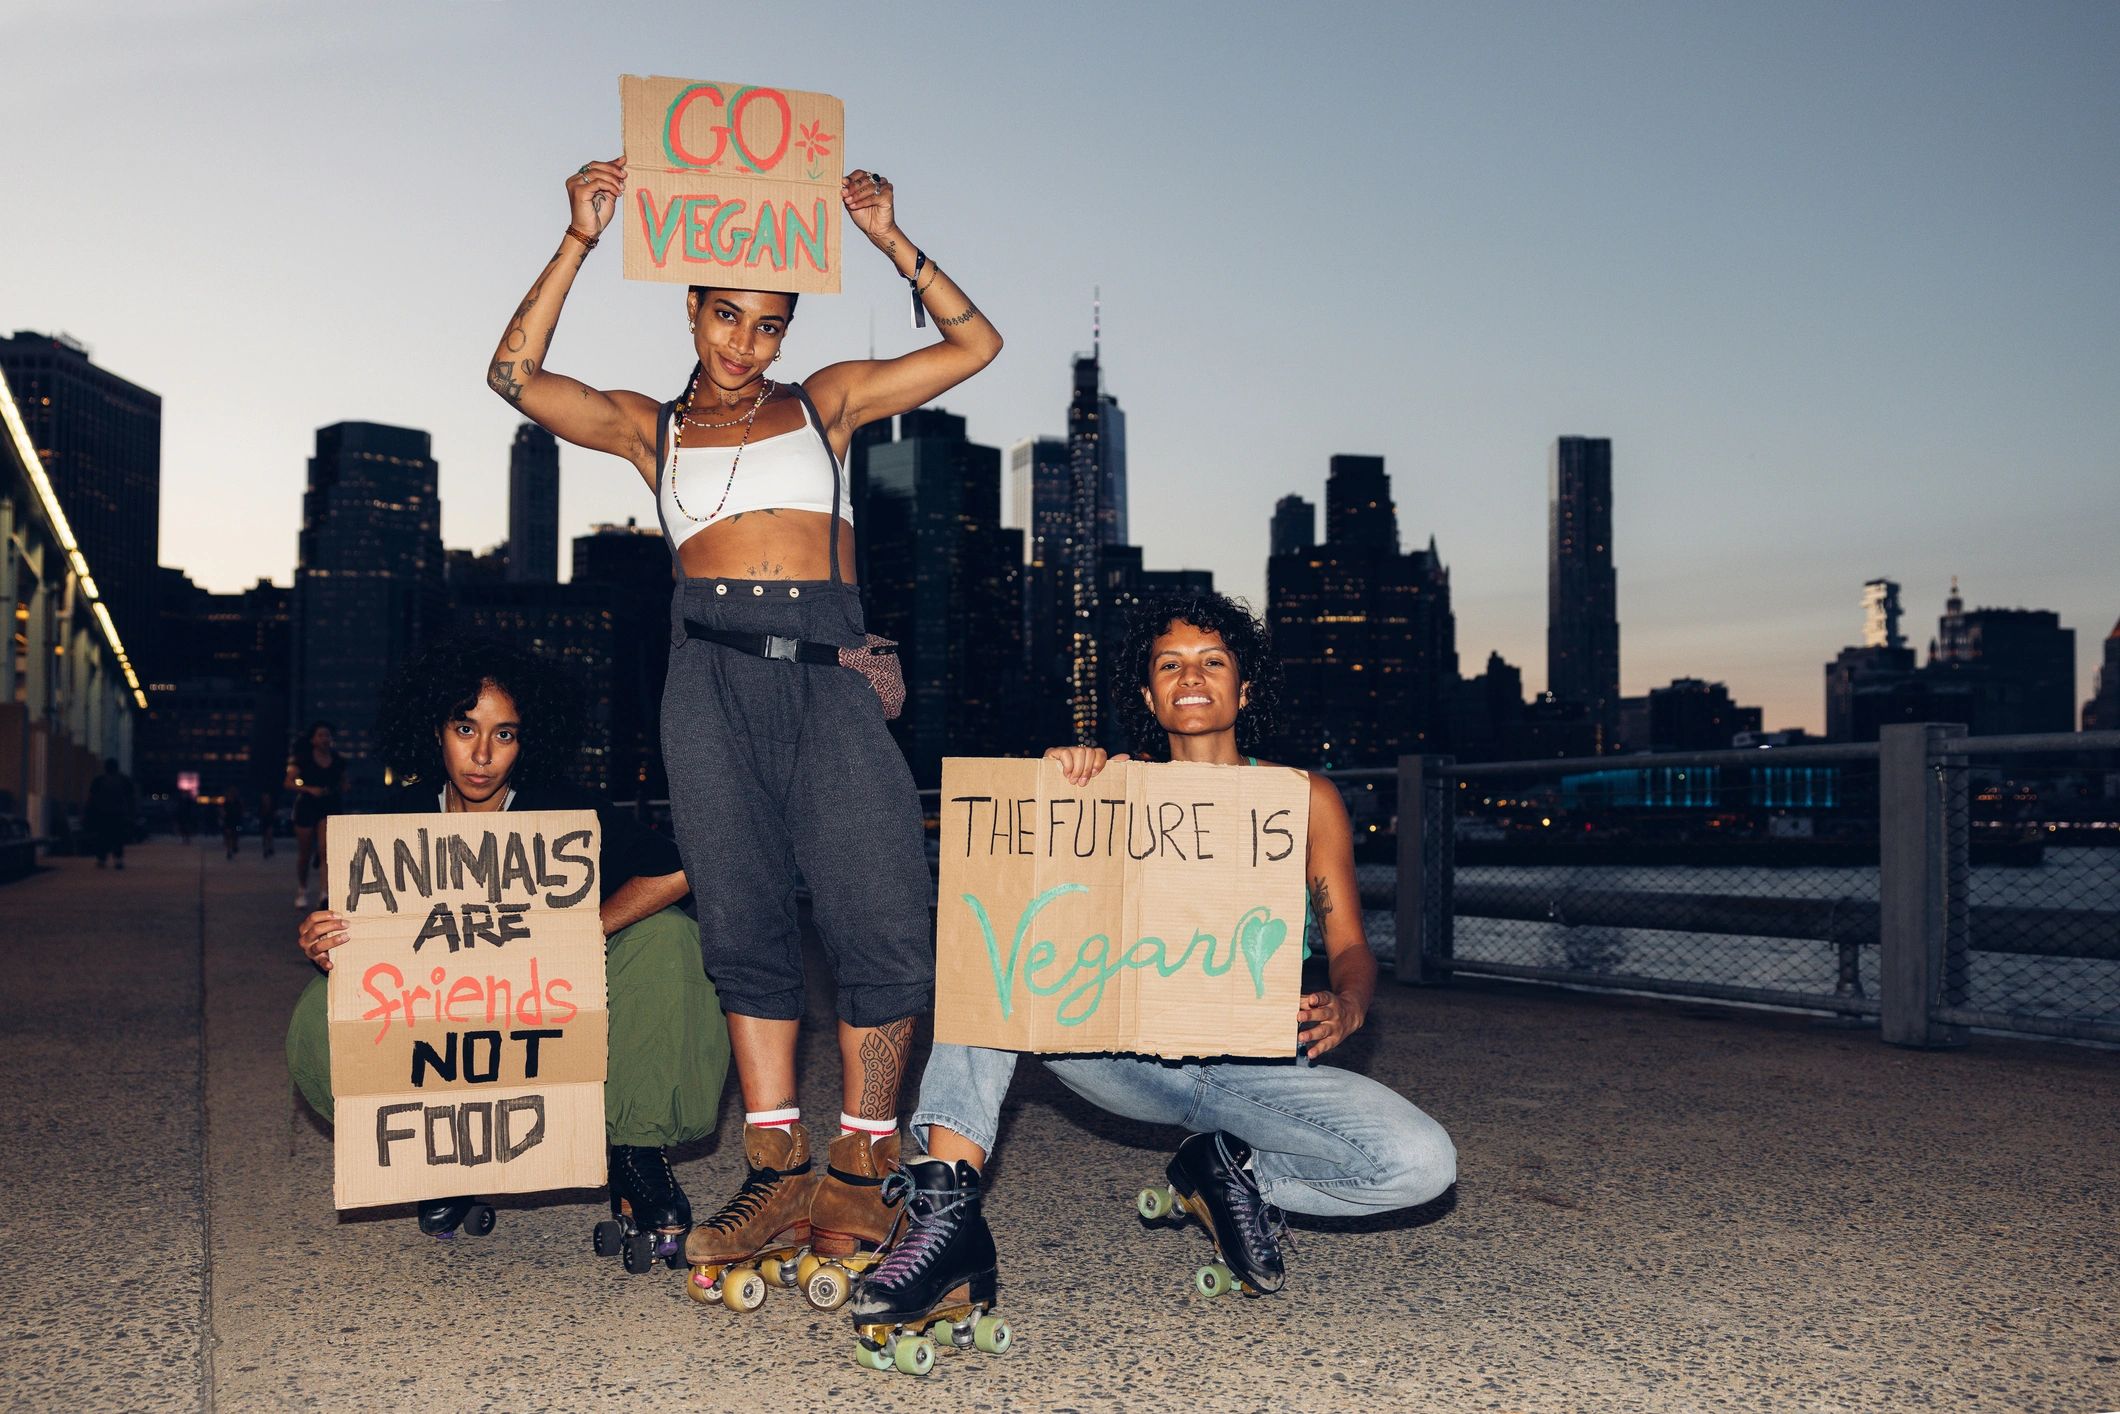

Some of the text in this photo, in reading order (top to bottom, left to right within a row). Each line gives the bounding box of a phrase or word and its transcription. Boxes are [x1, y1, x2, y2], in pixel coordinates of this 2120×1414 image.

[663, 83, 792, 174] GO
[636, 188, 829, 273] VEGAN
[346, 828, 596, 914] ANIMALS
[951, 796, 1294, 867] THE FUTURE IS
[413, 902, 531, 953] ARE
[961, 882, 1256, 1027] Vegan
[362, 957, 578, 1045] friends
[411, 1030, 563, 1087] NOT
[376, 1095, 545, 1168] FOOD
